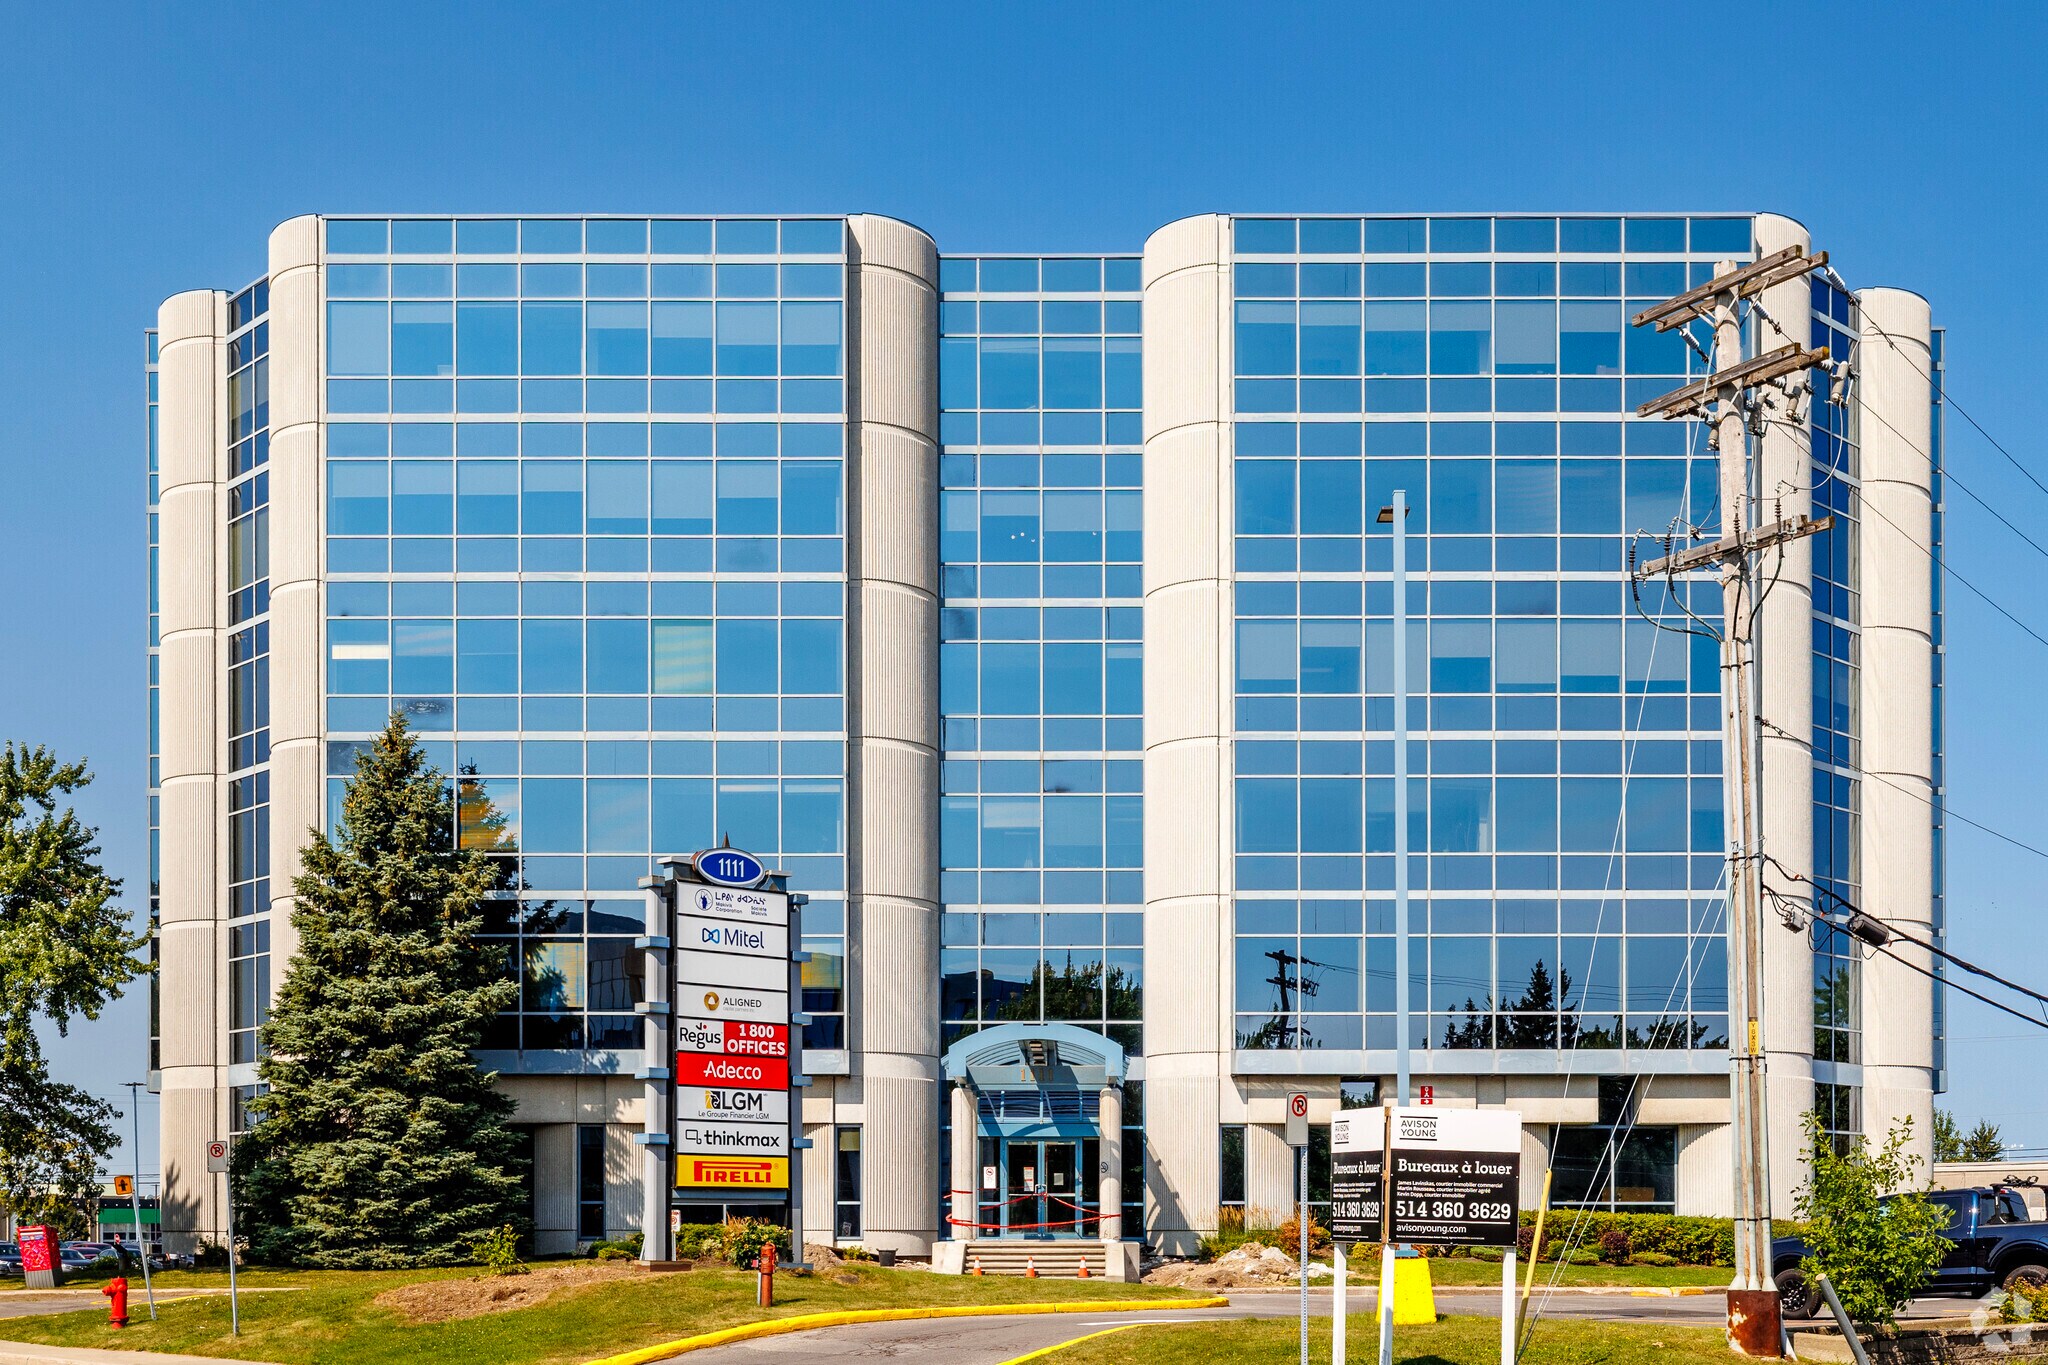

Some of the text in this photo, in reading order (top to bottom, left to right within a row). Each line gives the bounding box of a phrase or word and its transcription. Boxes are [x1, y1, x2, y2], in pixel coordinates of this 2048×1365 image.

[718, 858, 745, 878] 1111
[724, 928, 764, 949] Mitel
[723, 997, 762, 1008] ALIGNED
[680, 1027, 721, 1049] Regus
[738, 1024, 774, 1038] 1 800
[727, 1039, 786, 1056] OFFICES
[703, 1060, 762, 1080] Adecco
[722, 1091, 763, 1111] LGM
[706, 1111, 728, 1119] Groupe
[1401, 1120, 1437, 1128] AVISON
[704, 1130, 780, 1147] thinkmax
[1401, 1129, 1436, 1137] YOUNG
[694, 1161, 772, 1183] PIRELLI
[1333, 1160, 1380, 1174] Bureaux à louer
[1397, 1159, 1513, 1175] Bureaux à louer
[1332, 1201, 1379, 1218] 514 360 3629
[1395, 1200, 1511, 1219] 514 360 3629
[1396, 1223, 1467, 1234] avisonyoung.com
